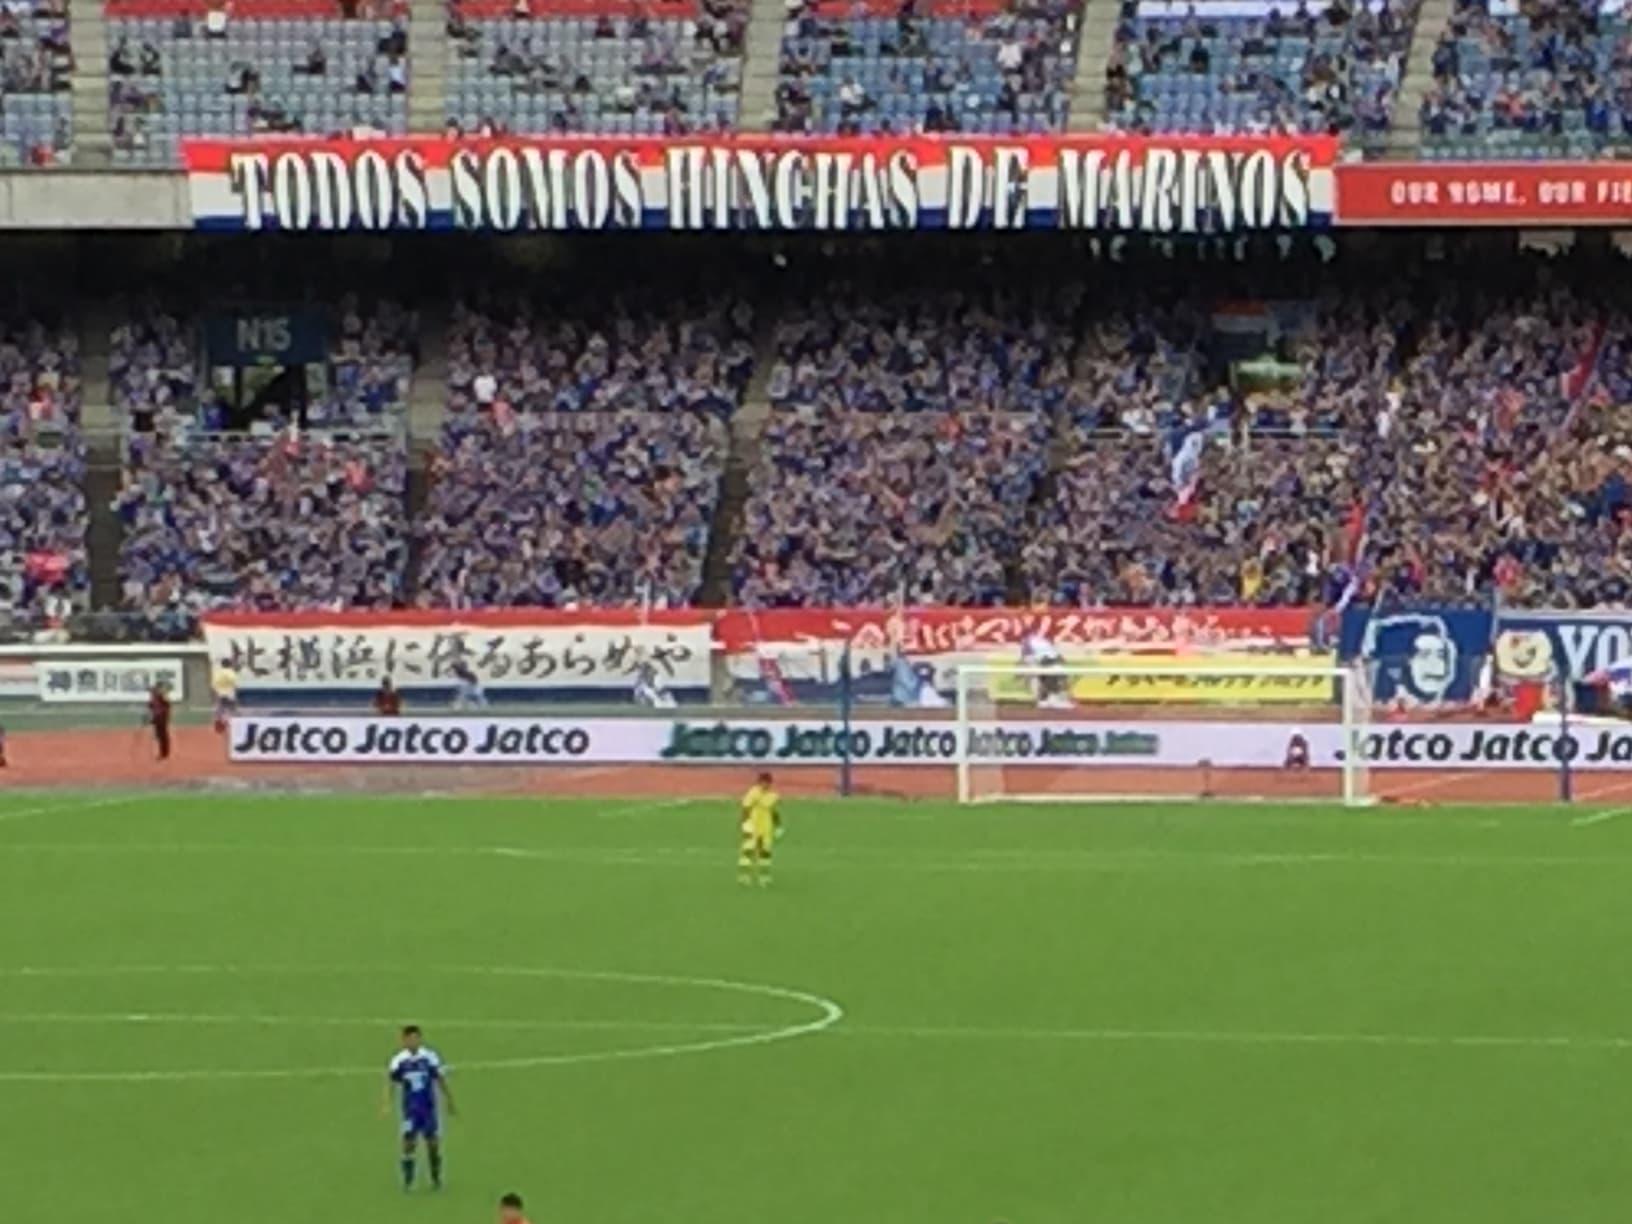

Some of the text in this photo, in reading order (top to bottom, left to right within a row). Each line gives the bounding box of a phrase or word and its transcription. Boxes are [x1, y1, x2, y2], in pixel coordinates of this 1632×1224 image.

[230, 145, 1312, 232] TODOS SOMOS HINCHAS DE MARINOS
[1390, 180, 1439, 204] OUR
[1538, 180, 1586, 204] OUR
[234, 723, 590, 756] Jatco Jatco Jatco
[875, 726, 957, 758] Jatco
[1460, 730, 1580, 762] Jatco
